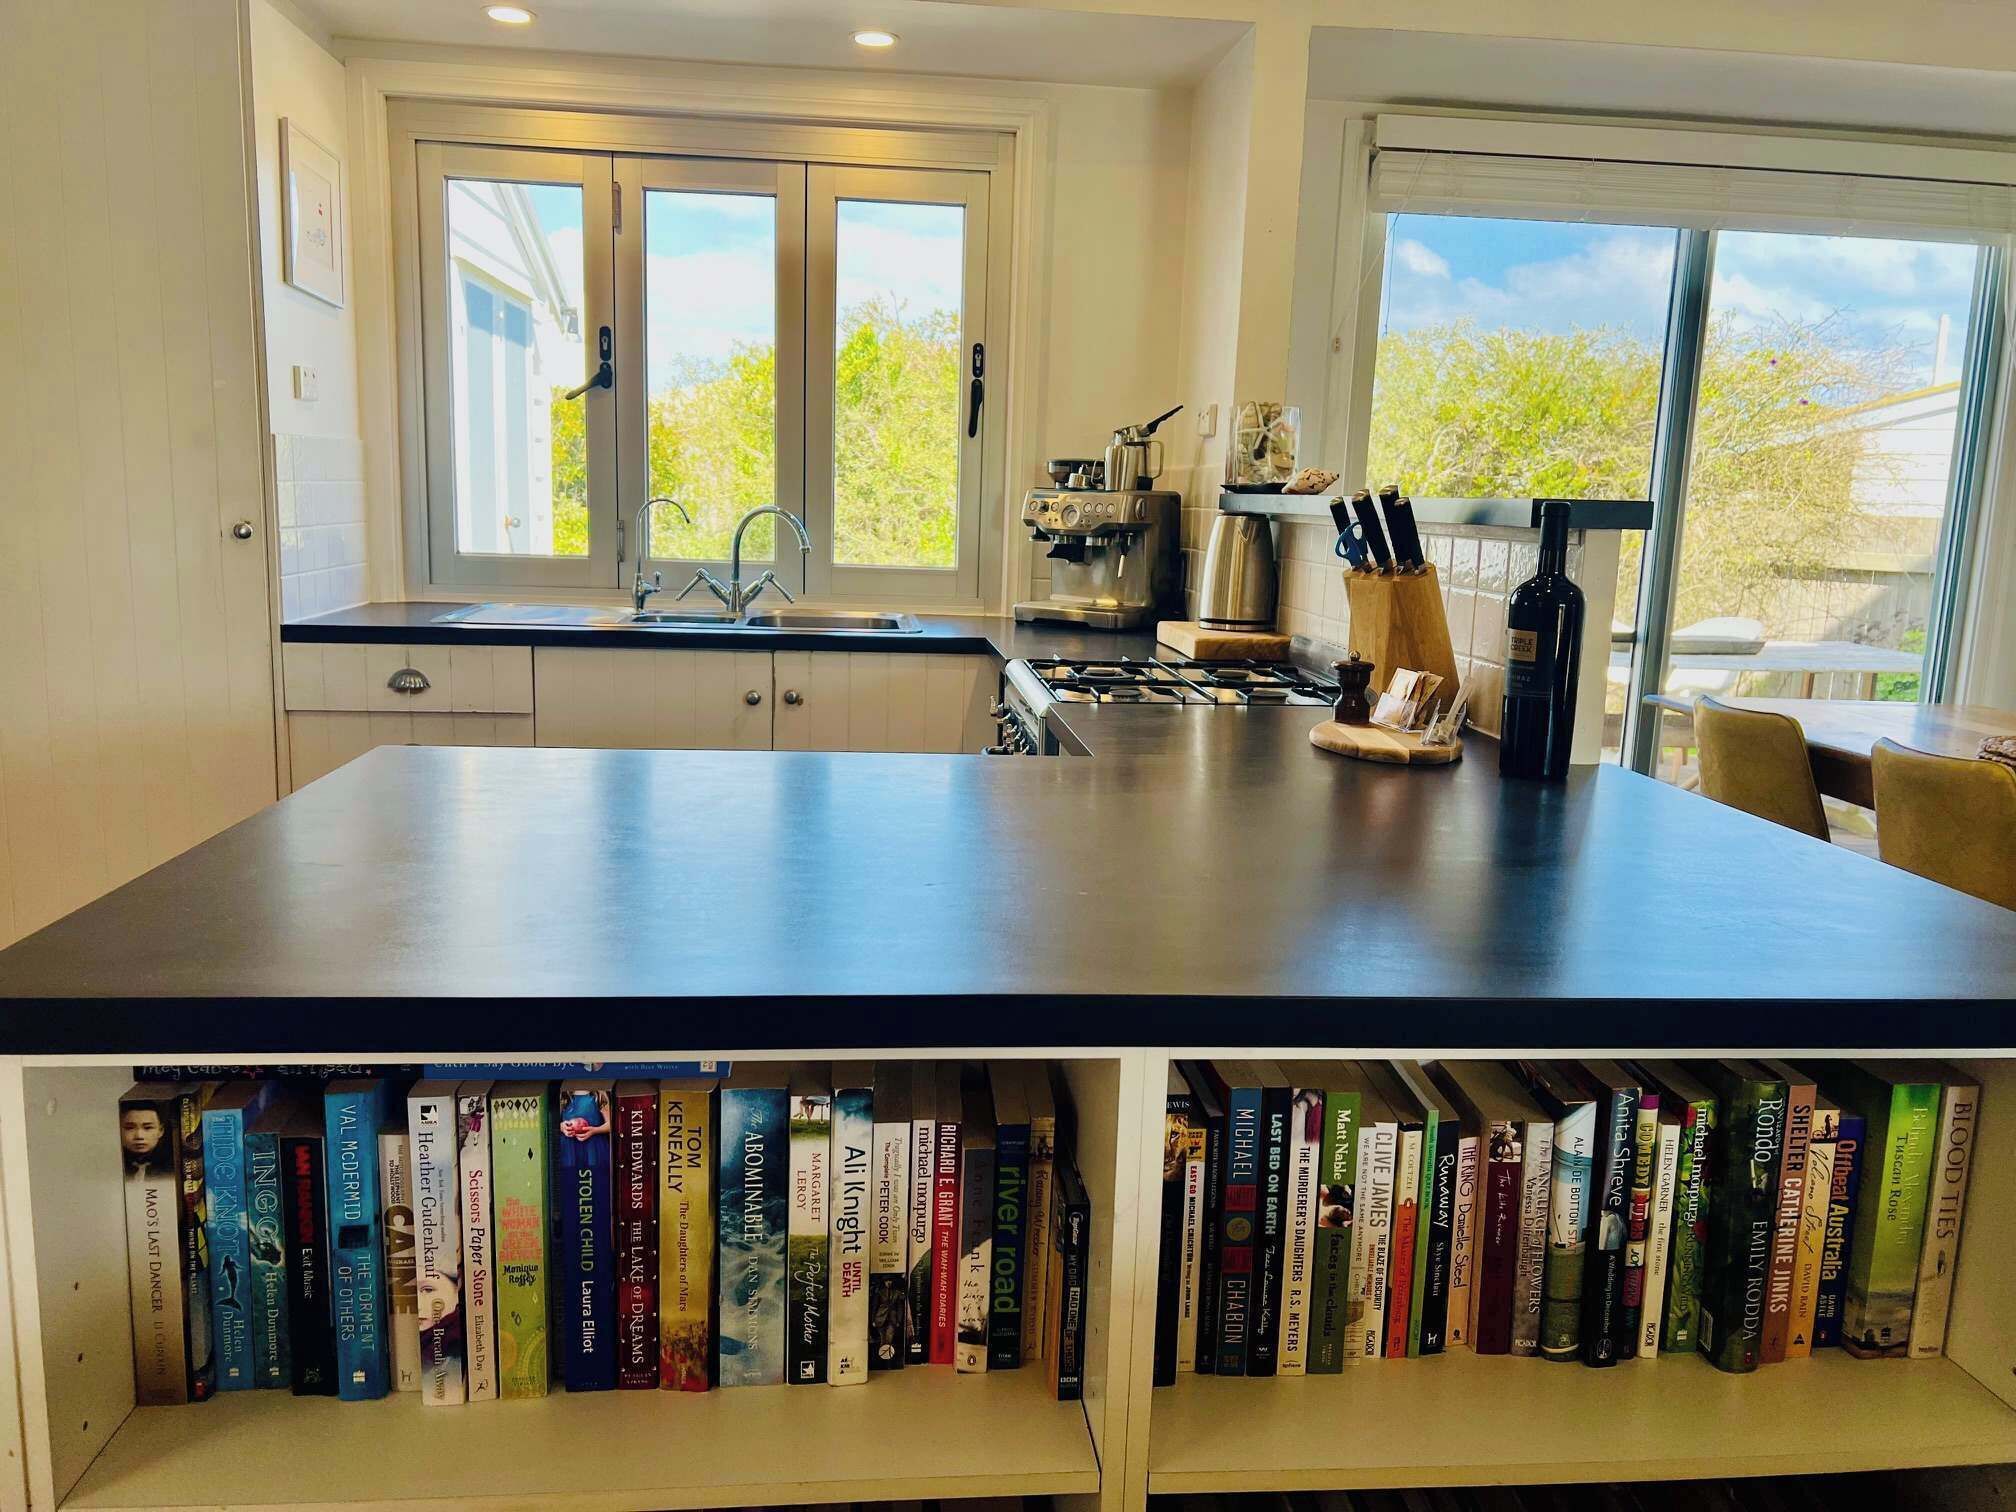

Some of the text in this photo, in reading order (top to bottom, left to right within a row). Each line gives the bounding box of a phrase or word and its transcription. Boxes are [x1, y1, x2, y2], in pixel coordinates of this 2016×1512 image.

[295, 1145, 312, 1176] IAN
[339, 1104, 361, 1220] VAL McDERMID
[631, 1110, 643, 1210] KIM EDWARDS
[668, 1101, 683, 1193] KENEALLY
[687, 1126, 702, 1168] TOM
[1333, 1109, 1351, 1181] Matt Nable
[1363, 1137, 1370, 1149] WE
[1608, 1092, 1635, 1207] Anita Shreve
[1754, 1099, 1783, 1162] Rondo
[213, 1117, 240, 1256] TIDE KNOT
[744, 1107, 765, 1241] The ABOMINABLE
[796, 1170, 807, 1211] LEROY
[810, 1152, 822, 1223] MARGARET
[837, 1146, 867, 1254] Ali Knight
[879, 1180, 890, 1213] PETER
[913, 1127, 933, 1244] michael morpurgo
[937, 1124, 957, 1228] RICHARD E. GRANT
[999, 1165, 1026, 1235] river
[1189, 1165, 1198, 1194] EASY GO
[1265, 1113, 1284, 1234] LAST BED ON EARTH
[1359, 1186, 1367, 1200] THE
[1369, 1132, 1393, 1228] CLIVE JAMES
[1433, 1154, 1456, 1228] Runaway
[1459, 1145, 1478, 1197] THE RING
[1524, 1177, 1537, 1215] Vanessa
[1569, 1136, 1585, 1226] ALAIN DE BOTTON
[1658, 1139, 1675, 1212] HELEN GARNER
[1683, 1108, 1709, 1227] michael morpurgo
[1803, 1149, 1830, 1254] Volcano Street
[1887, 1133, 1909, 1221] Tuscan Rose
[1937, 1103, 1972, 1240] BLOOD TIES
[418, 1132, 440, 1279] Heather Gudenkauf
[469, 1170, 488, 1307] Scissors Paper Stone
[578, 1169, 594, 1272] STOLEN CHILD
[630, 1220, 642, 1244] THE
[879, 1216, 889, 1244] COOK
[1186, 1197, 1197, 1263] MICHAEL CRICHTON
[1224, 1109, 1256, 1344] MICHAEL CHABON
[1291, 1146, 1311, 1282] THE MURDERER'S DAUGHTERS
[1528, 1138, 1551, 1313] The LANGUAGE of FLOWERS
[1769, 1105, 1811, 1313] SHELTER CATHERINE JINKS
[1821, 1140, 1857, 1280] Offbeat Australia
[146, 1189, 164, 1313] MAO'S LAST DANCER
[301, 1248, 315, 1299] Exit Music
[384, 1205, 418, 1316] CAINE
[629, 1246, 645, 1284] LAKE
[677, 1200, 690, 1312] The Daughters of Mars
[842, 1262, 852, 1298] DEATH
[852, 1262, 862, 1293] UNTIL
[938, 1231, 950, 1328] THE WAH-WAH DIARIES
[994, 1247, 1020, 1313] road
[1355, 1225, 1364, 1262] ANYMORE
[1373, 1233, 1387, 1311] THE BLAZE OF OBSCURITY
[1431, 1242, 1445, 1297] Skye Sinclair
[1453, 1203, 1473, 1288] Danielle Steel
[1654, 1222, 1667, 1276] the first stone
[265, 1272, 280, 1361] Helen Dunmore
[338, 1266, 355, 1342] OF OTHERS
[356, 1254, 375, 1352] THE TORMENT
[582, 1281, 595, 1354] Laura Elliot
[632, 1285, 643, 1301] OF
[747, 1255, 760, 1350] DAN SIMMONS
[793, 1247, 823, 1345] The Perfect Mother
[1742, 1221, 1769, 1341] EMILY RODDA
[1799, 1263, 1812, 1318] DAVID RAIN
[1826, 1294, 1837, 1317] DAVID
[223, 1311, 236, 1362] Dunmore
[233, 1320, 245, 1352] Helen
[433, 1328, 447, 1365] Breath
[474, 1315, 487, 1372] Elizabeth Day
[630, 1303, 645, 1364] DREAMS
[1286, 1290, 1302, 1352] R.S. MEYERS
[1365, 1330, 1376, 1356] PICADOR
[1644, 1322, 1656, 1347] PICADOR
